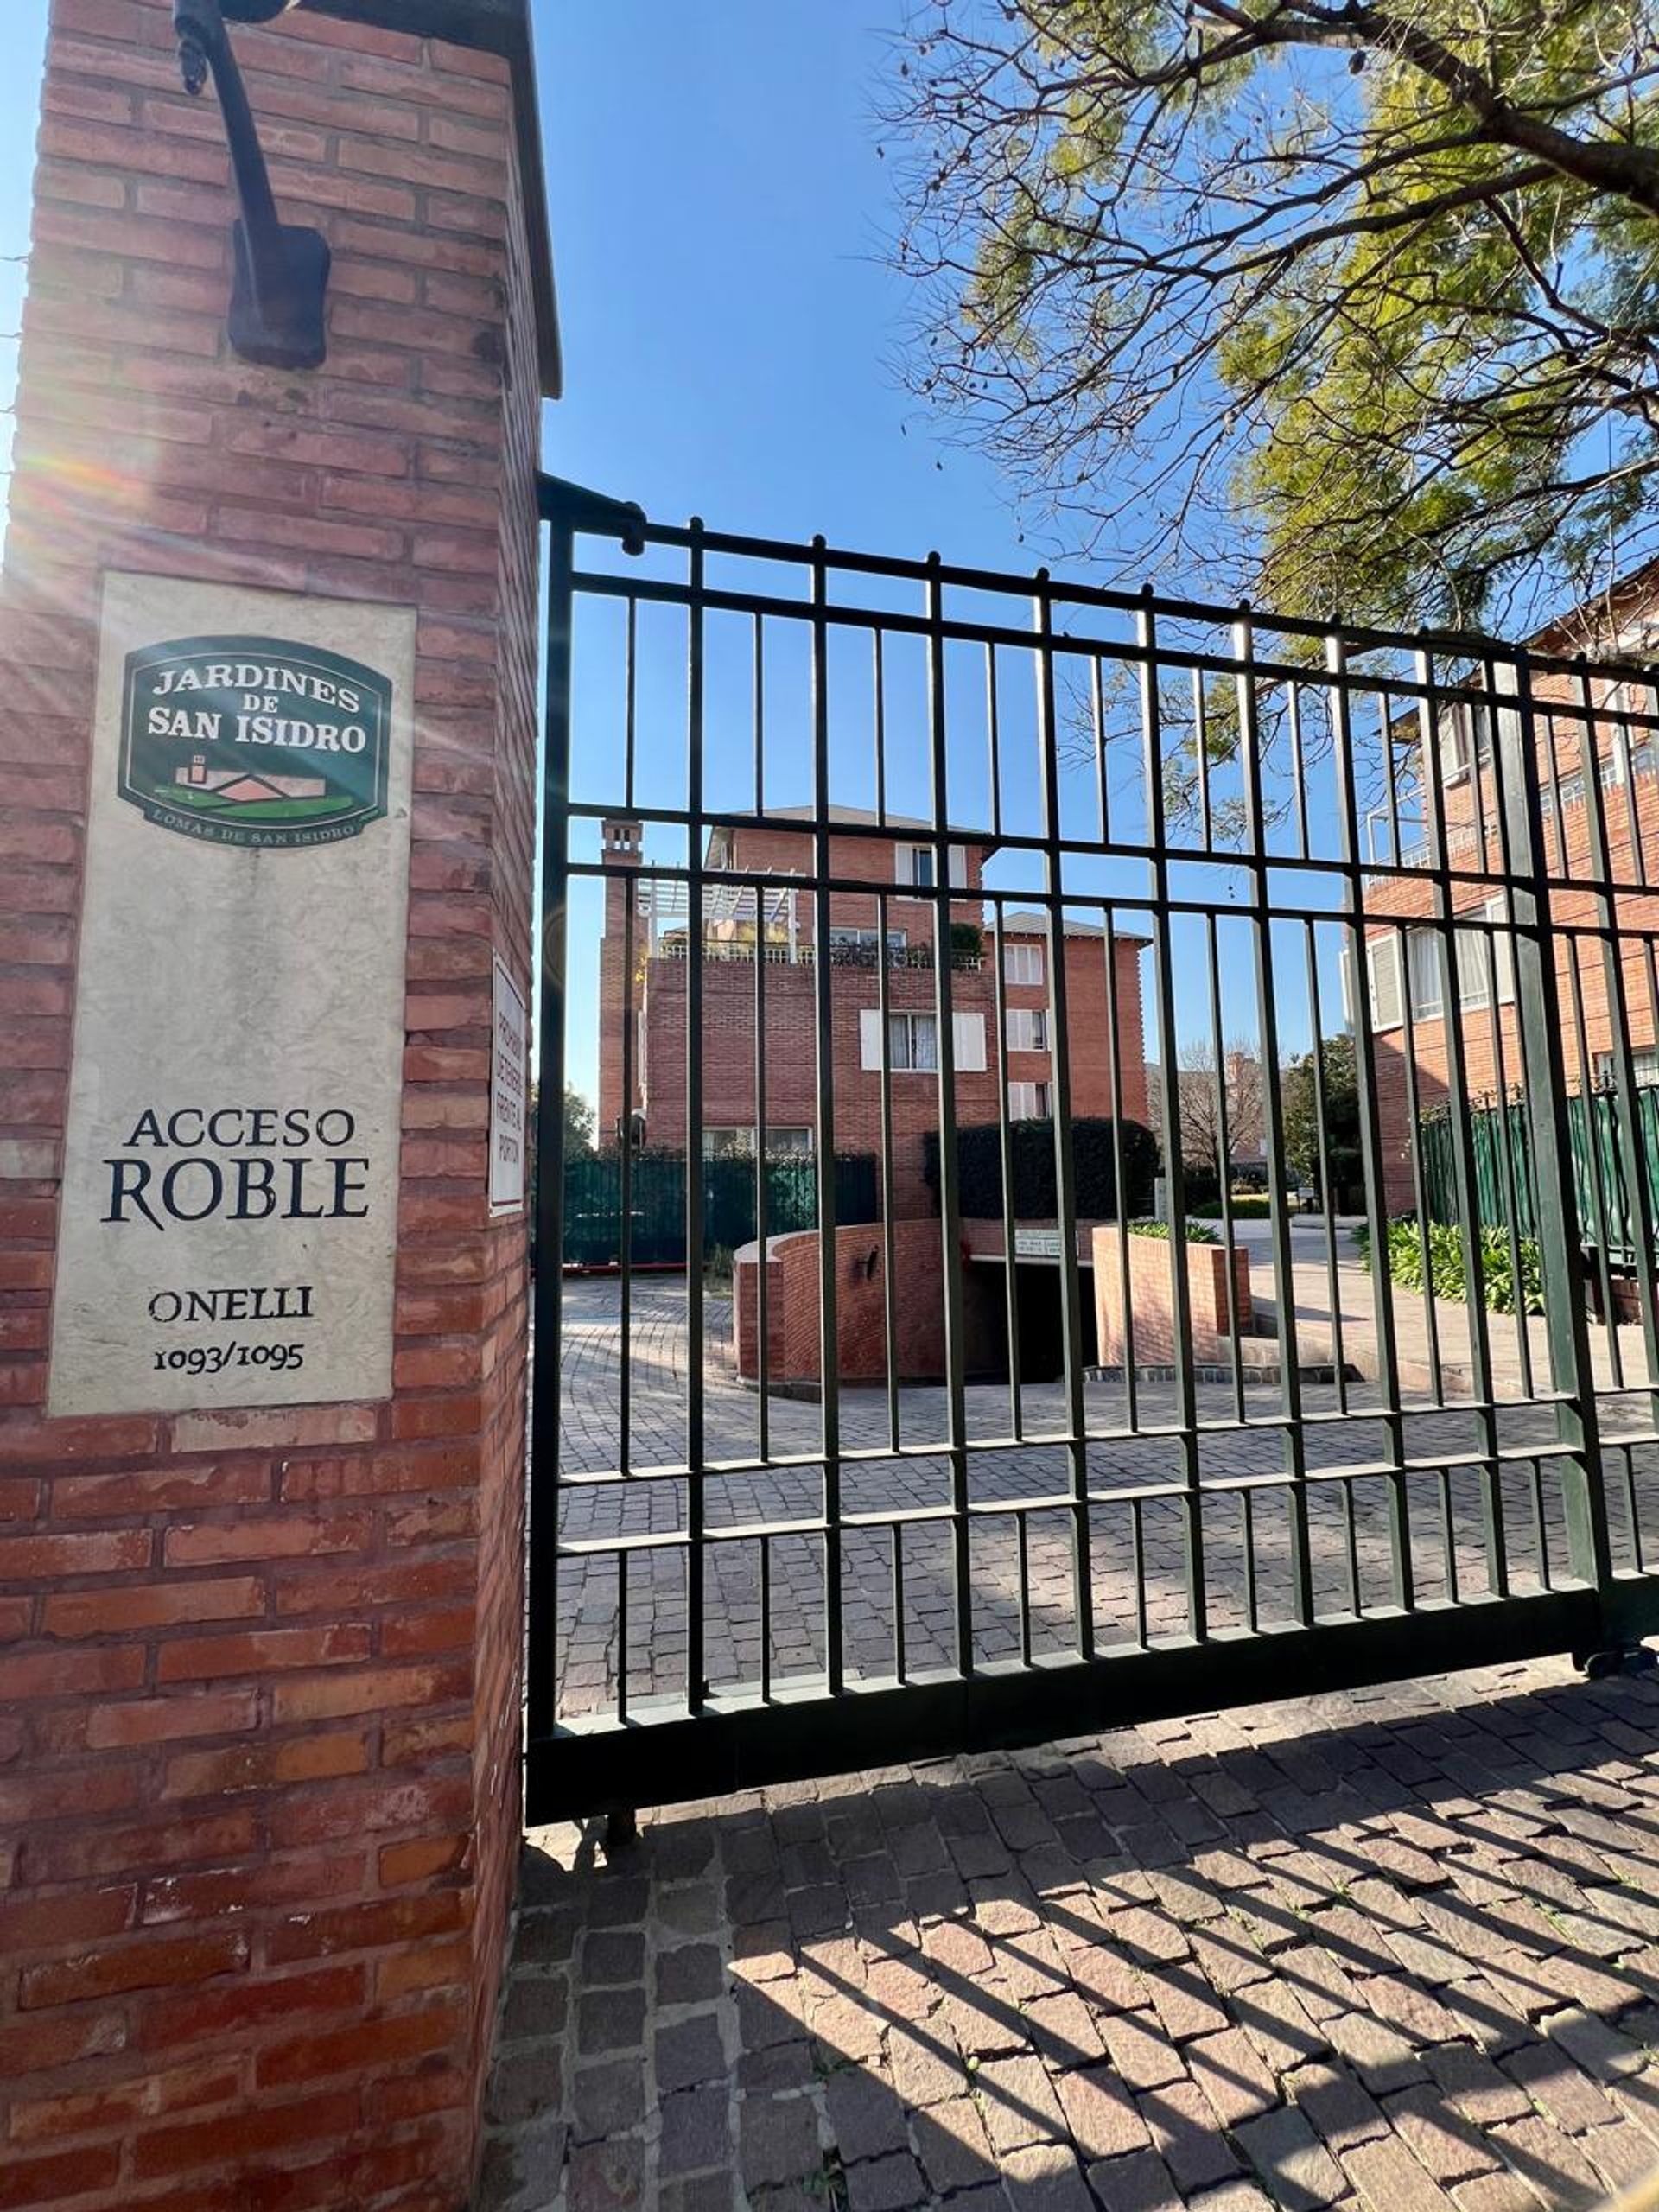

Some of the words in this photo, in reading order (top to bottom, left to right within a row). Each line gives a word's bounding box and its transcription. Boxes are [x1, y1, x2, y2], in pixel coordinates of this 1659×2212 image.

[153, 664, 360, 714] JARDINES
[243, 694, 279, 713] DE
[148, 707, 222, 740] SAN
[235, 715, 366, 753] ISIDRO
[152, 808, 215, 836] LOMAS
[221, 830, 245, 843] DE
[251, 832, 287, 845] SAN
[295, 825, 356, 843] ISIDRO
[122, 1109, 355, 1147] ACCESO
[100, 1157, 369, 1231] ROBLE
[148, 1286, 314, 1323] ONELLI
[153, 1341, 305, 1375] 1093/1095
